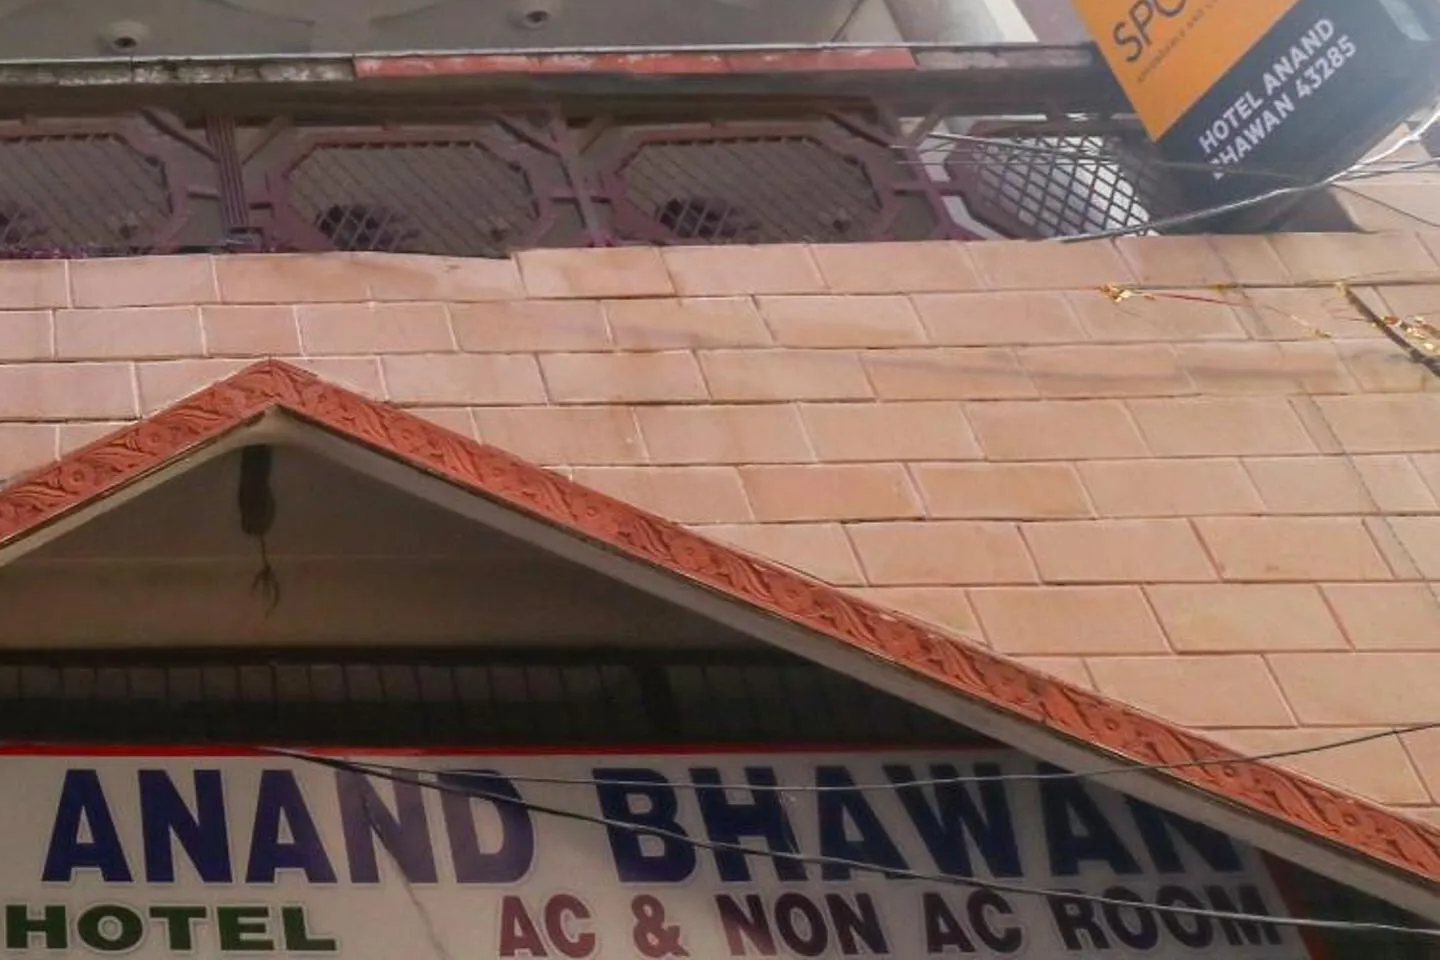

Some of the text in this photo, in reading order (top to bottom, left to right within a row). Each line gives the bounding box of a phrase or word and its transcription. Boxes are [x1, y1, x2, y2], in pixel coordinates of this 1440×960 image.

[1198, 90, 1264, 155] HOTEL
[1261, 18, 1335, 96] ANAND
[1294, 34, 1357, 100] 43285
[41, 768, 535, 885] ANAND
[5, 904, 337, 952] HOTEL
[499, 885, 1283, 959] AC & NON AC ROOM
